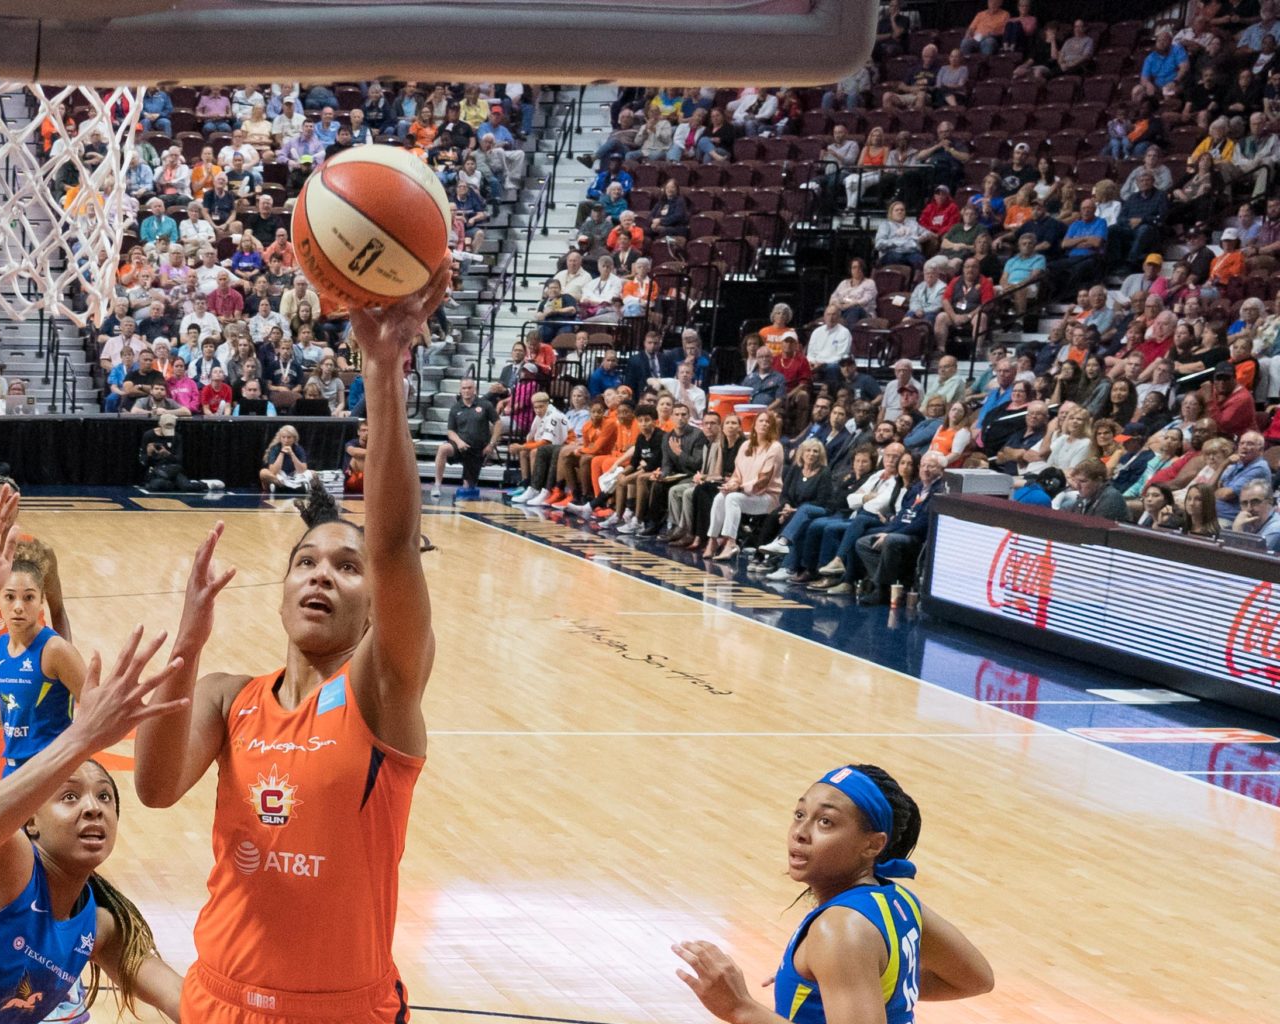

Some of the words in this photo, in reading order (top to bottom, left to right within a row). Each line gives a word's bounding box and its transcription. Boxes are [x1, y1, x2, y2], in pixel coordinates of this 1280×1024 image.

[307, 736, 337, 751] Sun
[261, 815, 285, 824] SUN
[264, 851, 326, 877] AT&T
